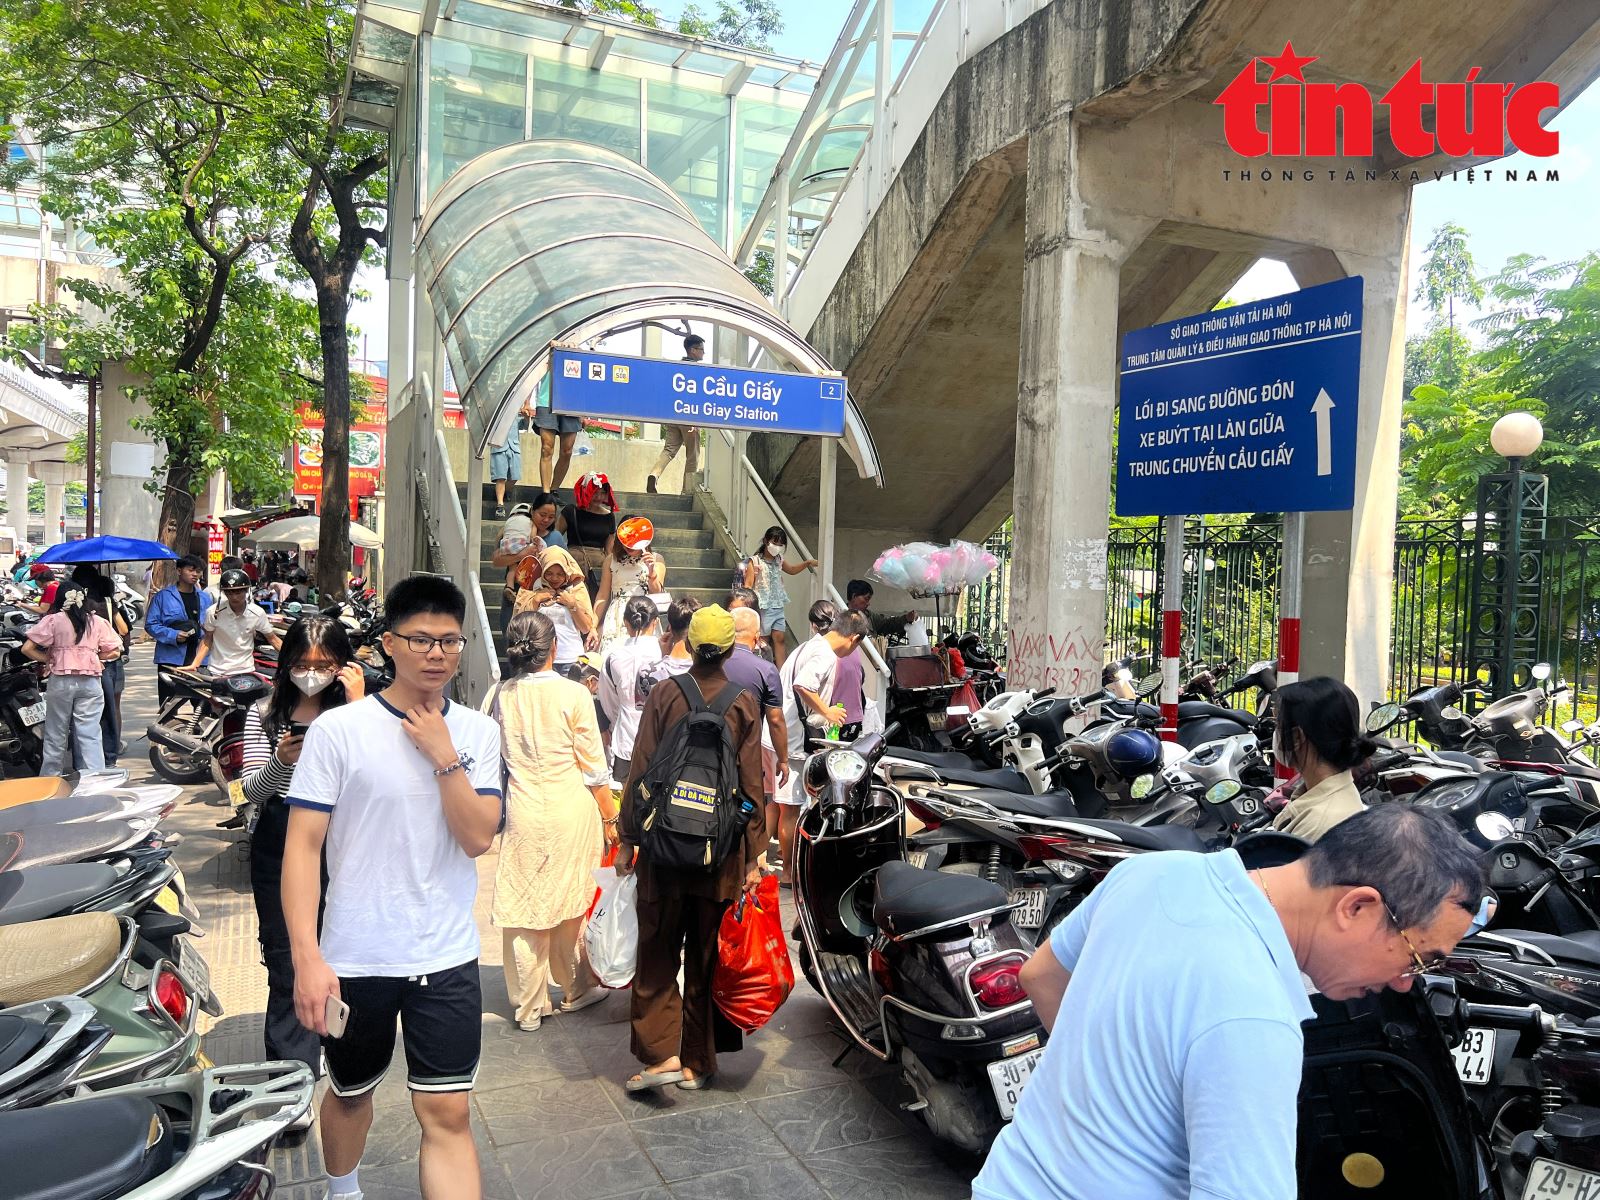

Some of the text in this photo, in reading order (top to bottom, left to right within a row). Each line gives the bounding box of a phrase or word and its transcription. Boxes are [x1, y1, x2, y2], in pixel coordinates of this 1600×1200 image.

[1182, 323, 1200, 337] GIAO
[1202, 316, 1227, 333] THÔNG
[1229, 312, 1246, 328] VẬN
[1247, 306, 1260, 324] TẢI
[1262, 304, 1274, 320] HÀ
[1276, 301, 1292, 319] NỘI
[1127, 353, 1149, 368] TRUNG
[1150, 348, 1165, 363] TÂM
[1166, 344, 1187, 359] QUẢN
[1250, 329, 1270, 344] GIAO
[1272, 322, 1302, 340] THÔNG
[1304, 320, 1316, 334] TP
[1318, 314, 1332, 332] HÀ
[1334, 310, 1352, 330] NỘI
[672, 372, 782, 406] Ga Cầu Giấy
[829, 385, 835, 395] 2
[1134, 378, 1295, 421] LỐI ĐI SANG ĐƯỜNG ĐÓN
[673, 399, 779, 422] Cau Giay Station
[1139, 411, 1285, 448] XE BUÝT TẠI LÀN GIỮA
[1129, 441, 1295, 478] TRUNG CHUYỂN CẦU GIẤY
